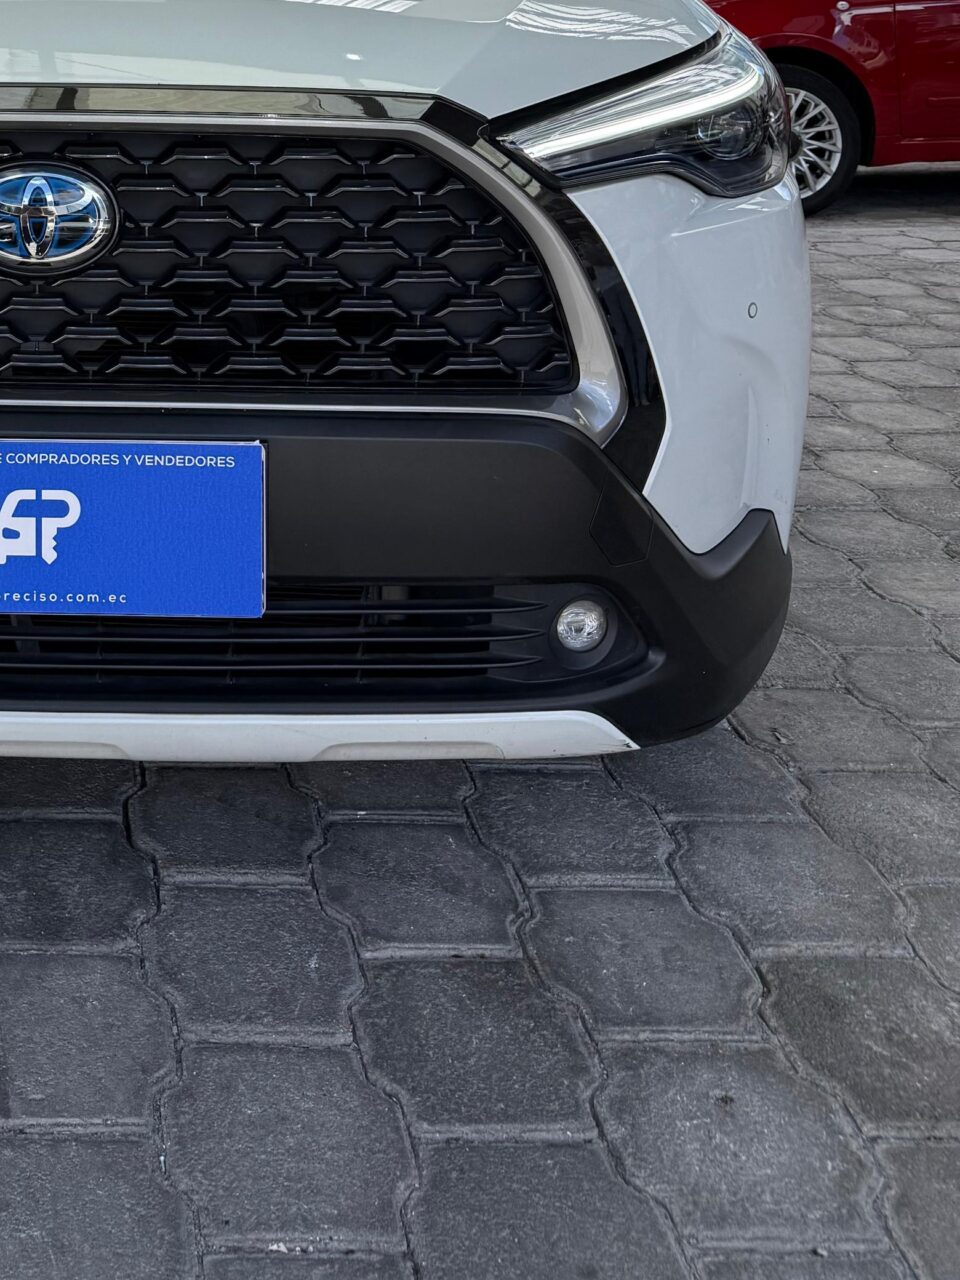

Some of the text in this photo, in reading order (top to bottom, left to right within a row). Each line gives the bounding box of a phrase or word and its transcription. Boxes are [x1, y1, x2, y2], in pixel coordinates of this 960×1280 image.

[5, 453, 120, 466] COMPRADORES
[123, 454, 132, 465] Y
[134, 455, 235, 468] VENDEDORES
